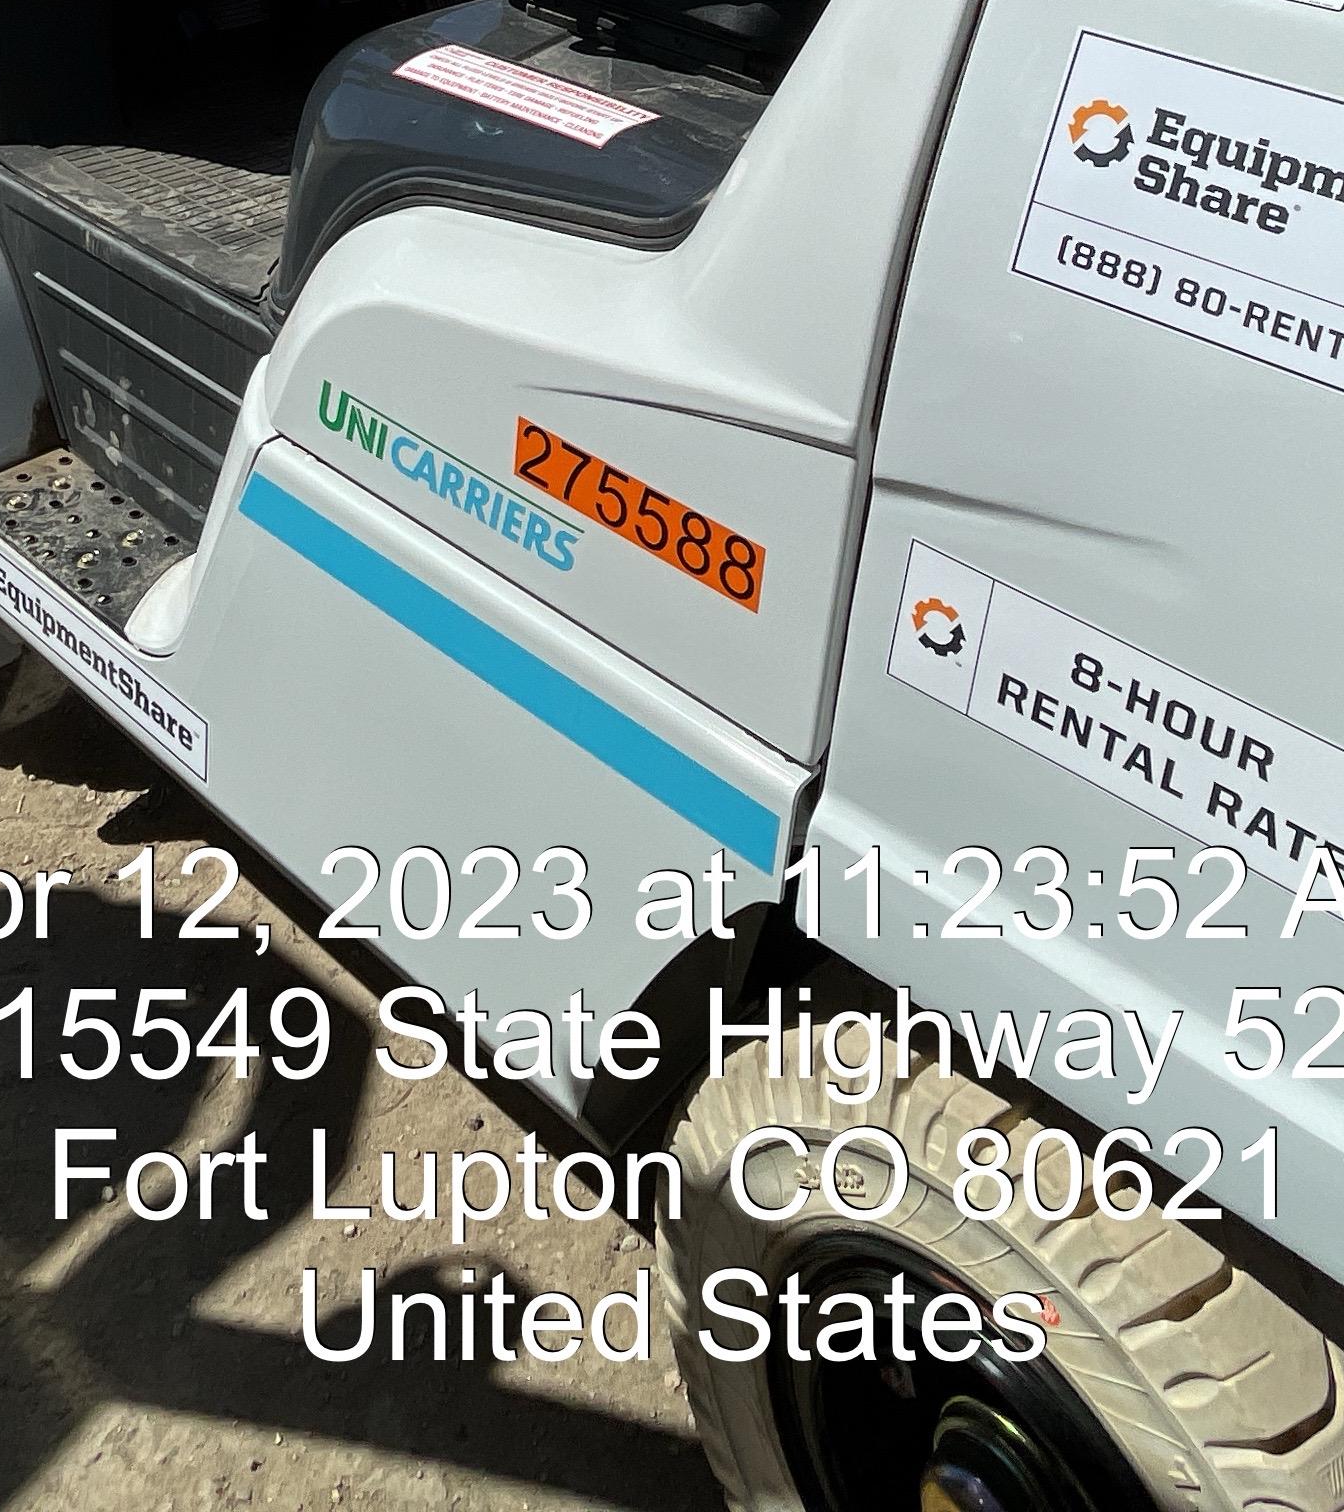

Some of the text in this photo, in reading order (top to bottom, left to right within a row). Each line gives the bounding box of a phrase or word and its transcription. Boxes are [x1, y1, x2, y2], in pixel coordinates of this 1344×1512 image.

[1134, 154, 1290, 235] Share
[1057, 235, 1162, 295] (888)
[319, 379, 579, 572] UNICARRIERS
[519, 425, 758, 600] 275588
[997, 673, 1183, 799] RENTAL
[1071, 652, 1274, 782] 8-HOUR
